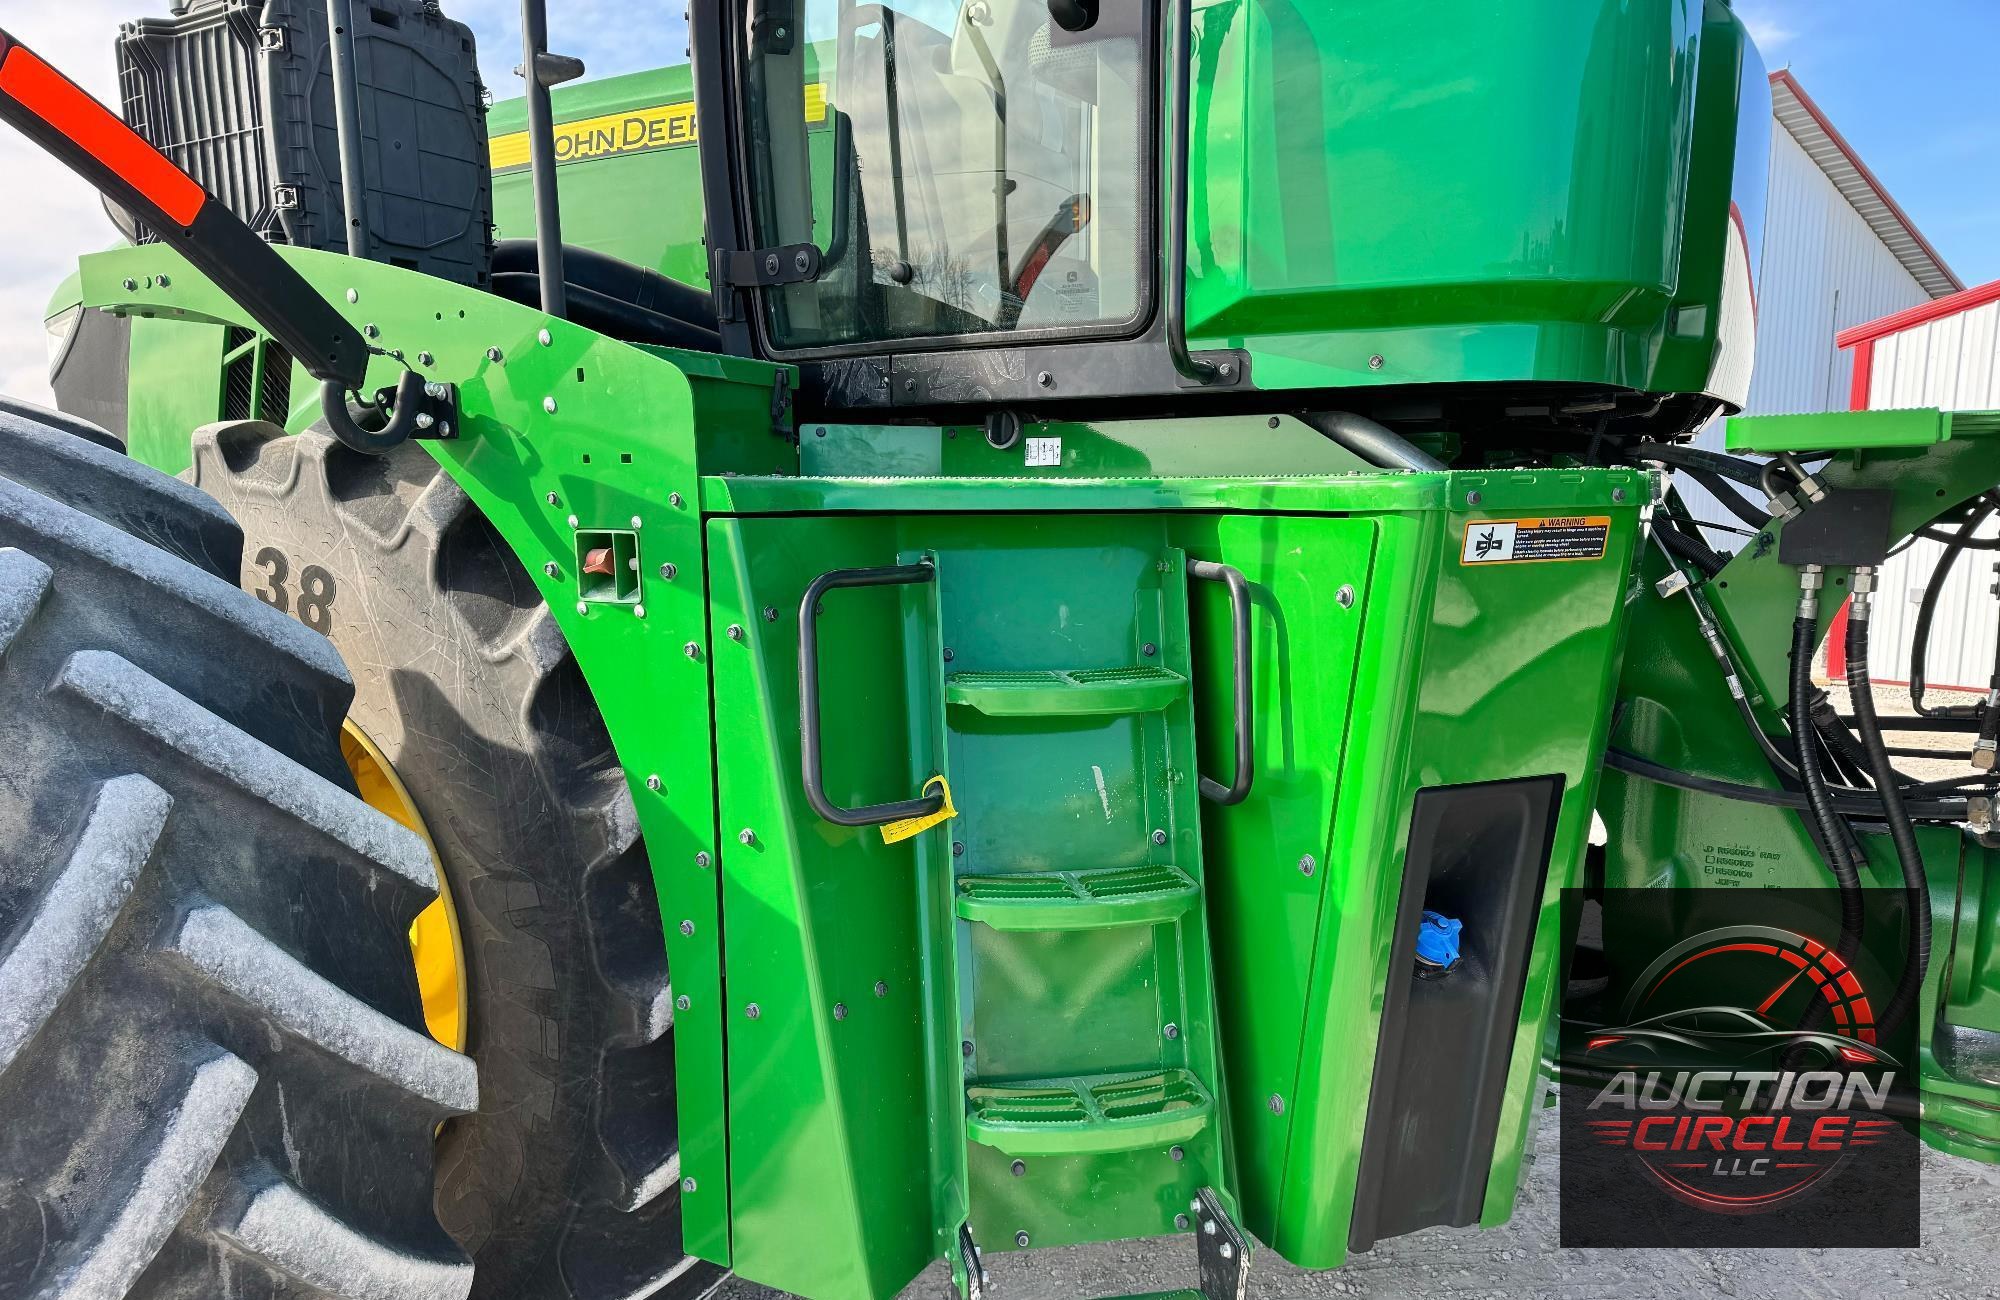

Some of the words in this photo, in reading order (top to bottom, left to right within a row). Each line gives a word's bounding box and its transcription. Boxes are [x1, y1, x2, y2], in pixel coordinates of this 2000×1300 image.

[555, 127, 615, 156] OHN
[623, 114, 697, 146] DEE
[1548, 518, 1586, 527] WARNING
[255, 546, 336, 637] 38
